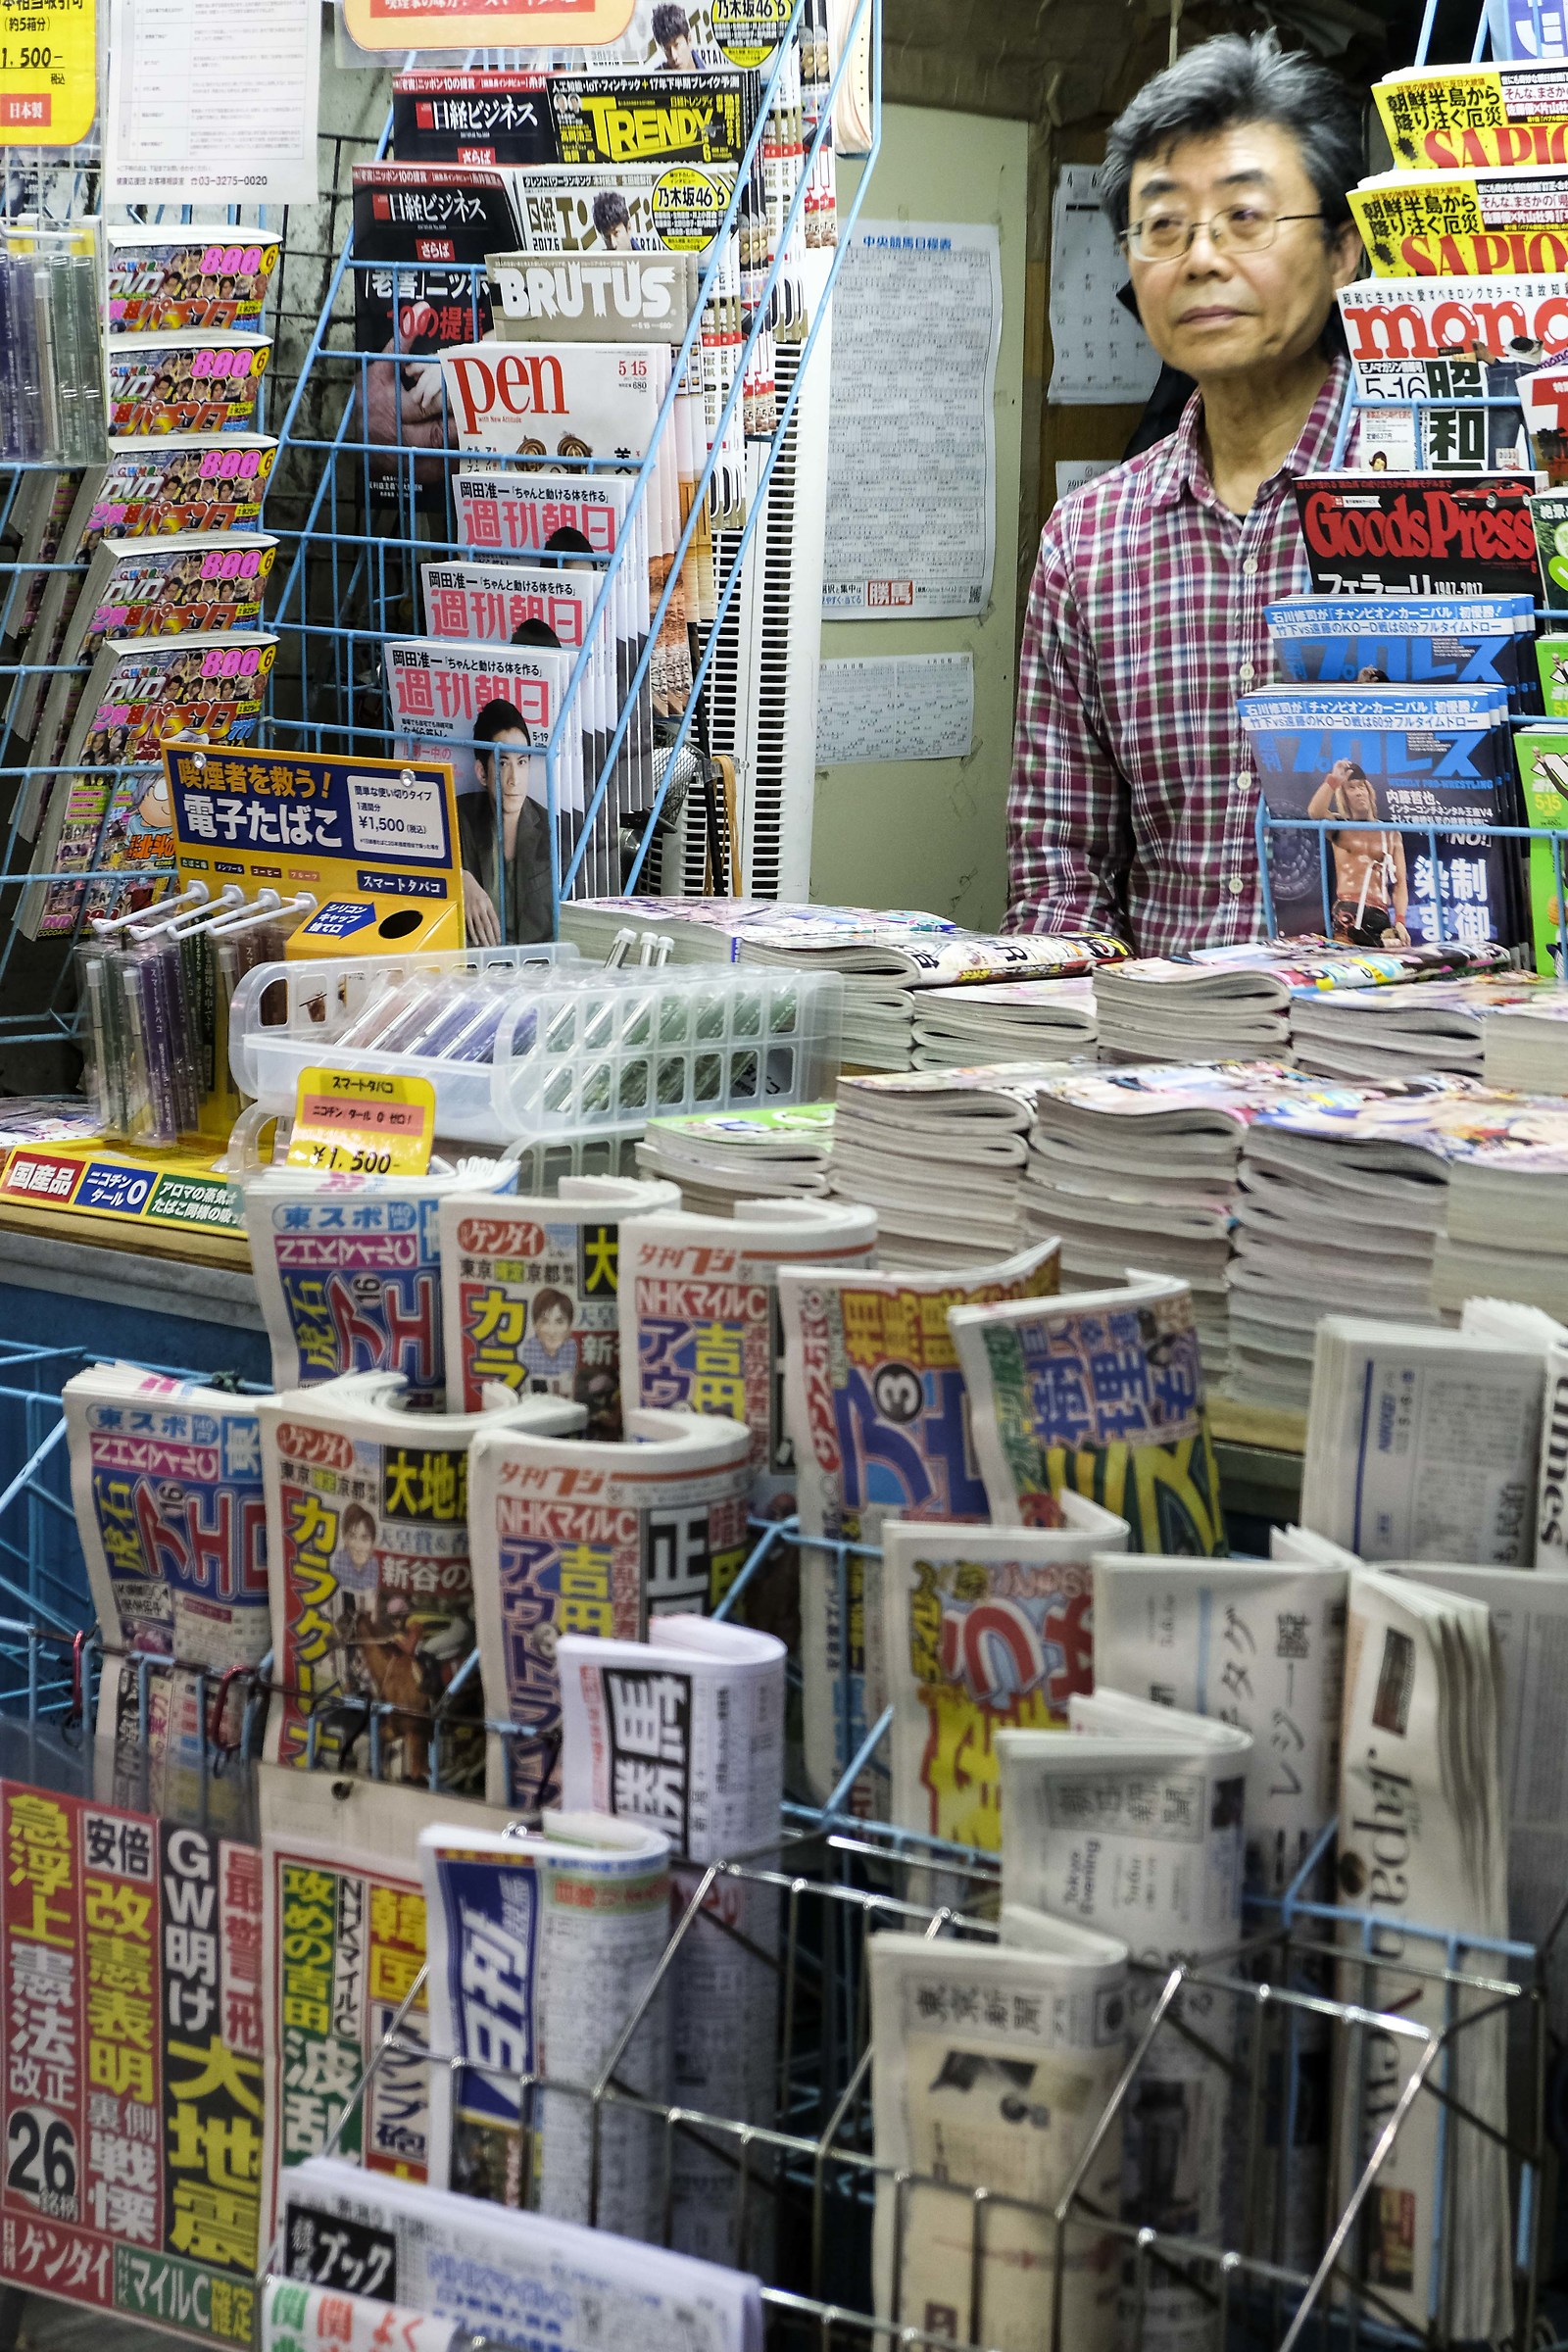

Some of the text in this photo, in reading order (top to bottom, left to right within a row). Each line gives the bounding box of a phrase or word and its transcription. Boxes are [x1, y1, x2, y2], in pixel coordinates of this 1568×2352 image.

[1387, 86, 1500, 113] 朝鮮半島から
[1505, 86, 1568, 101] そんな、まさか
[9, 102, 43, 120] 日本製
[433, 95, 538, 130] 日経ビジネス
[1394, 108, 1503, 132] 降り注ぐ厄災
[582, 96, 713, 162] TRENDY
[390, 191, 487, 223] 日経ビジネス
[658, 186, 712, 208] 乃木坂46
[1362, 194, 1477, 221] 朝鮮半島から
[1370, 216, 1480, 240] 降り注ぐ厄災
[421, 242, 450, 259] さらば
[1400, 232, 1567, 277] SAPIO
[493, 261, 676, 319] BRUTUS
[1343, 284, 1568, 306] 昭和に生まれた愛すべきロングセラーで温故知
[447, 355, 569, 435] pen
[102, 676, 167, 705] DVD
[177, 760, 333, 798] 喫煙者を救う！
[354, 785, 432, 802] 簡単な使い切りタイプ
[357, 802, 381, 812] 1週間分
[183, 794, 343, 848] 電子たばこ
[252, 867, 281, 877] コーヒー
[363, 875, 441, 894] スマートタバコ
[318, 912, 362, 924] キャップ
[327, 903, 368, 914] シリコン
[308, 922, 344, 935] 捨て口
[312, 1105, 343, 1118] ニコチン
[7, 1162, 74, 1195] 国産品
[85, 1172, 129, 1189] ニコチン
[91, 1188, 125, 1206] タール
[283, 1206, 383, 1231] 東スポ
[470, 1221, 542, 1253] ゲンダイ
[637, 1243, 735, 1275] 夕刊フジ
[638, 1284, 766, 1321] NHKマイルC
[100, 1410, 187, 1437] 東スポ
[290, 1426, 350, 1467] ゲンダイ
[386, 1451, 469, 1521] 大地
[499, 1460, 606, 1495] 夕刊フジ
[498, 1501, 639, 1546] NHKマイルC
[87, 1818, 149, 1873] 安倍
[164, 1830, 217, 2033] GW明け
[8, 2111, 76, 2196] 26
[20, 2223, 111, 2299] ゲンダイ
